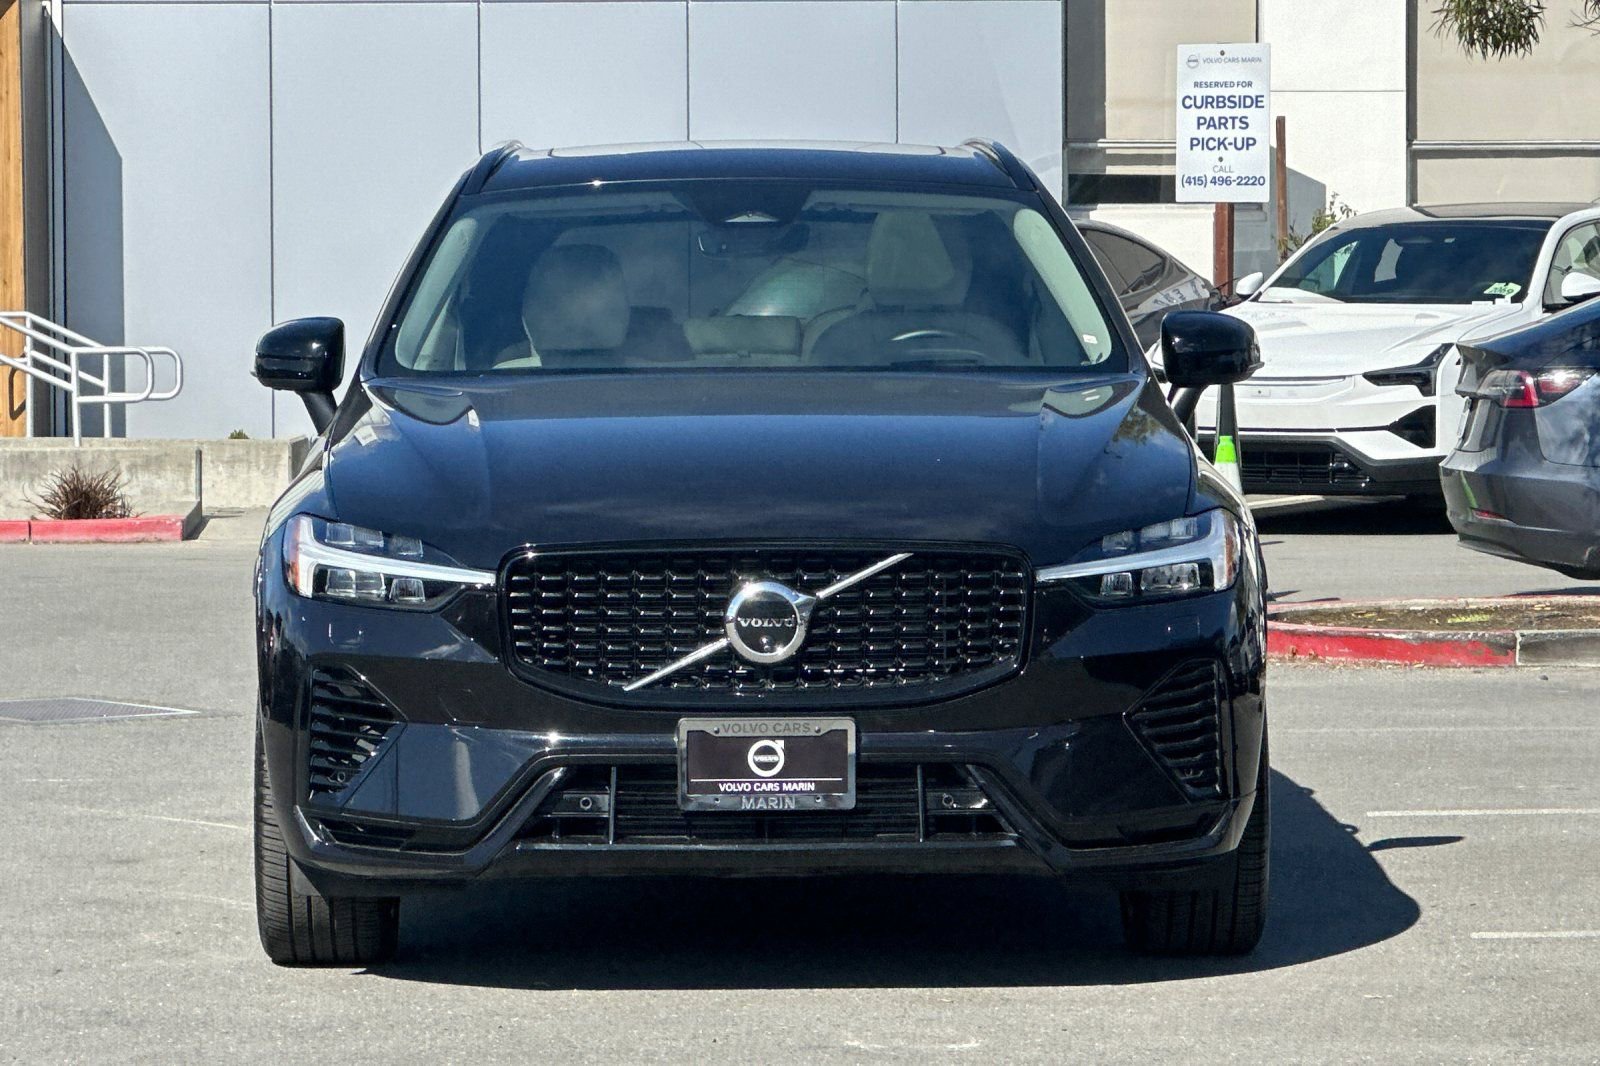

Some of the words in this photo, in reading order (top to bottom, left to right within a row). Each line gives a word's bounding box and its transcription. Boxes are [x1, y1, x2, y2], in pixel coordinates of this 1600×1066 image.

[1194, 81, 1235, 89] RESERVED
[1182, 95, 1265, 109] CURBSIDE
[1197, 116, 1249, 130] PARTS
[1190, 137, 1257, 151] PICK-UP
[1213, 165, 1234, 173] CALL
[1181, 174, 1208, 188] (415)
[1210, 175, 1266, 187] 496-2220
[738, 617, 795, 628] VOLVO
[721, 723, 769, 734] VOLVO
[772, 722, 811, 734] CARS
[719, 783, 751, 792] VOLVO
[753, 783, 780, 791] CARS
[782, 782, 815, 791] MARIN
[741, 796, 795, 810] MARIN
